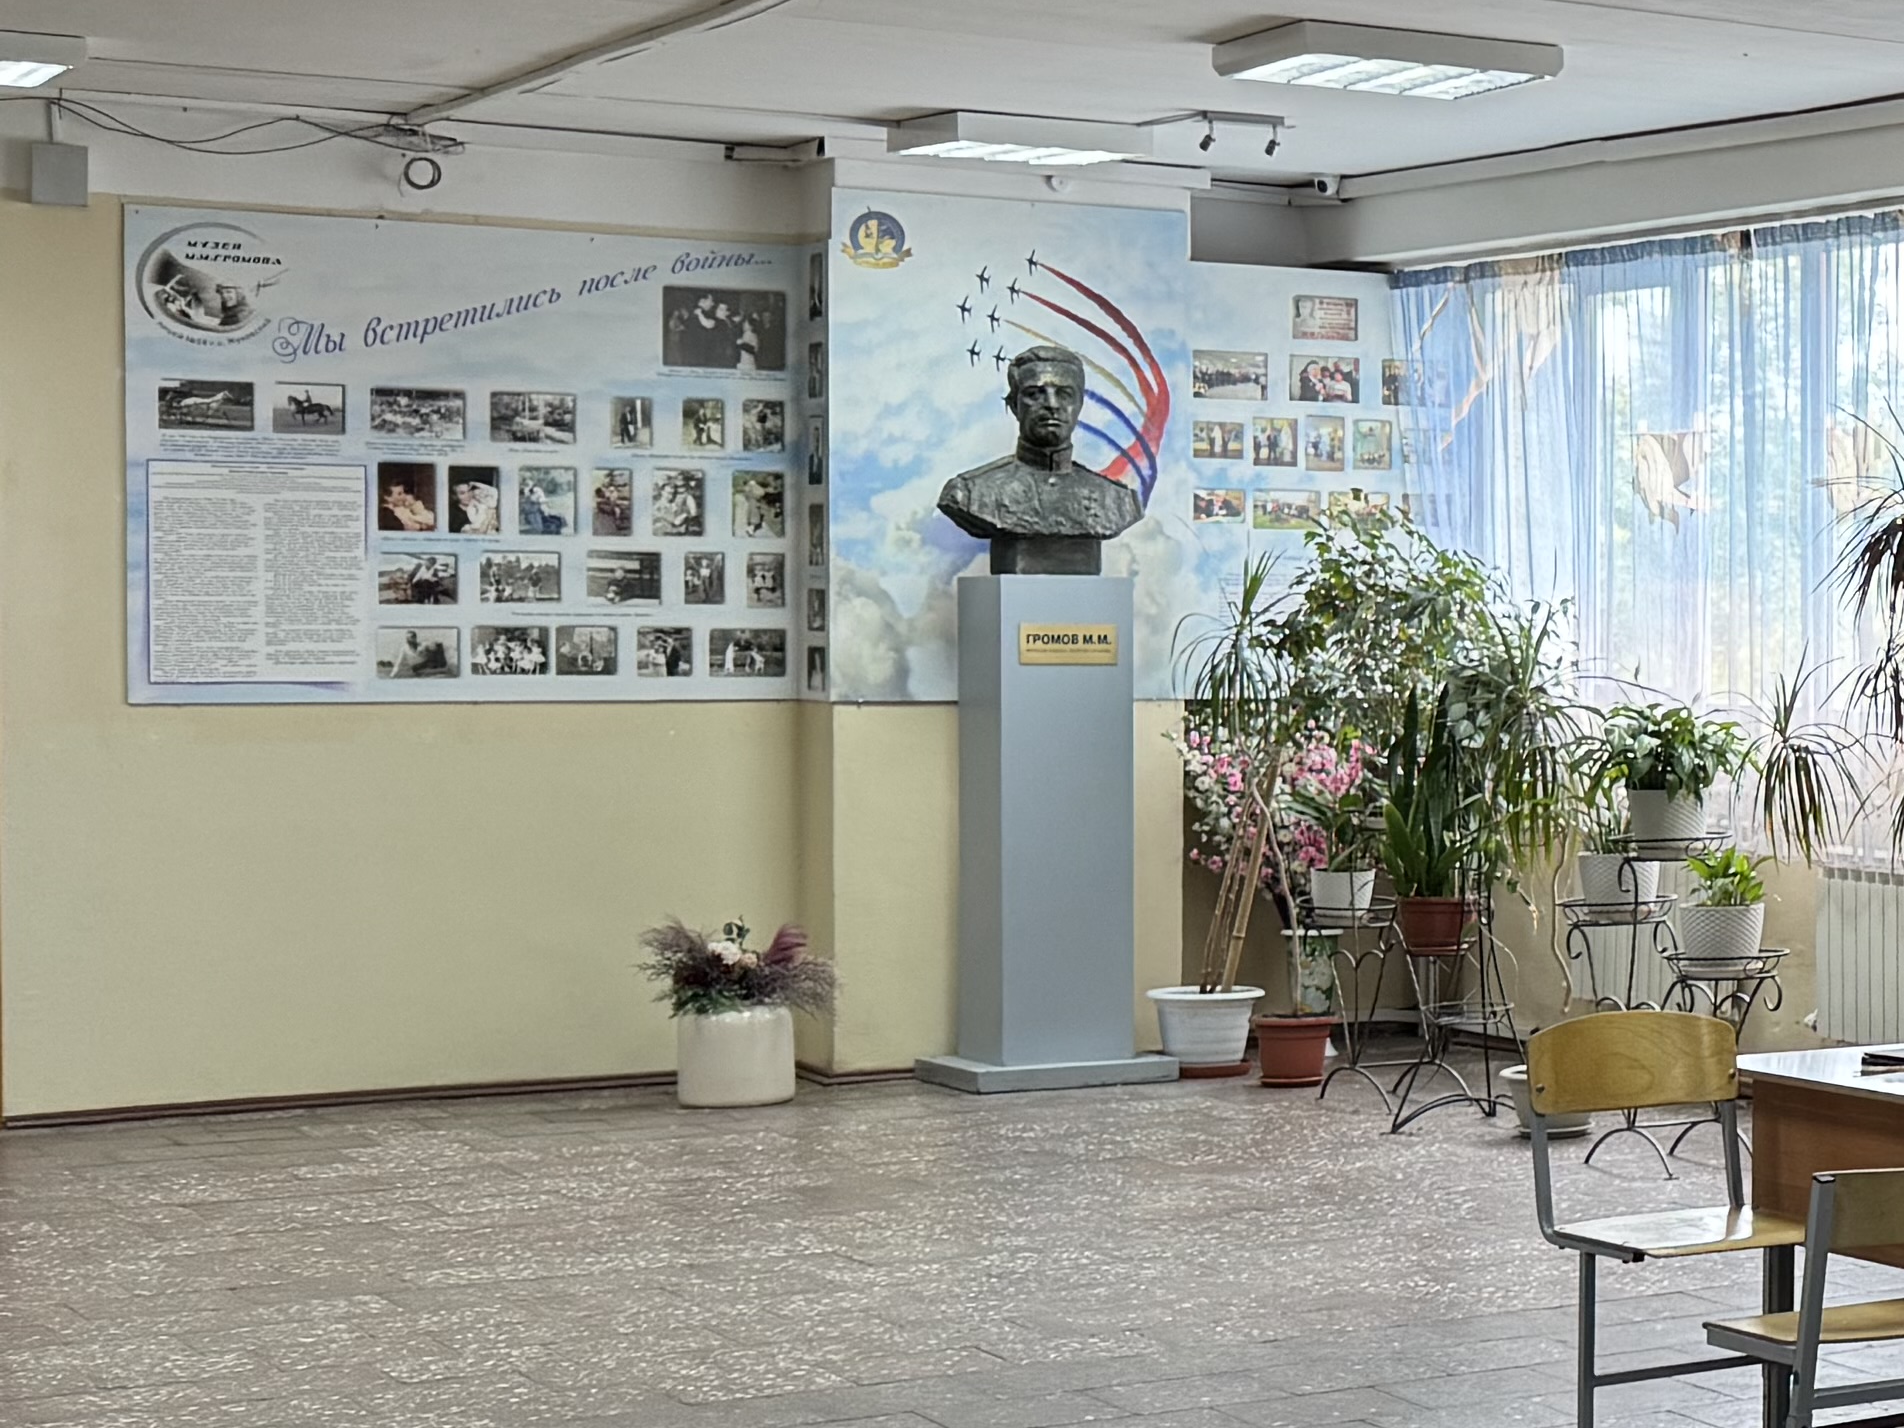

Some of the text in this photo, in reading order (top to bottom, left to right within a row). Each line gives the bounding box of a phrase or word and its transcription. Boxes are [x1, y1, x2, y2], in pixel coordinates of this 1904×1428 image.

[272, 317, 347, 363] Мы
[363, 285, 562, 349] встретились
[578, 262, 658, 297] после
[1026, 634, 1112, 645] ГРОМОВ М.М.
